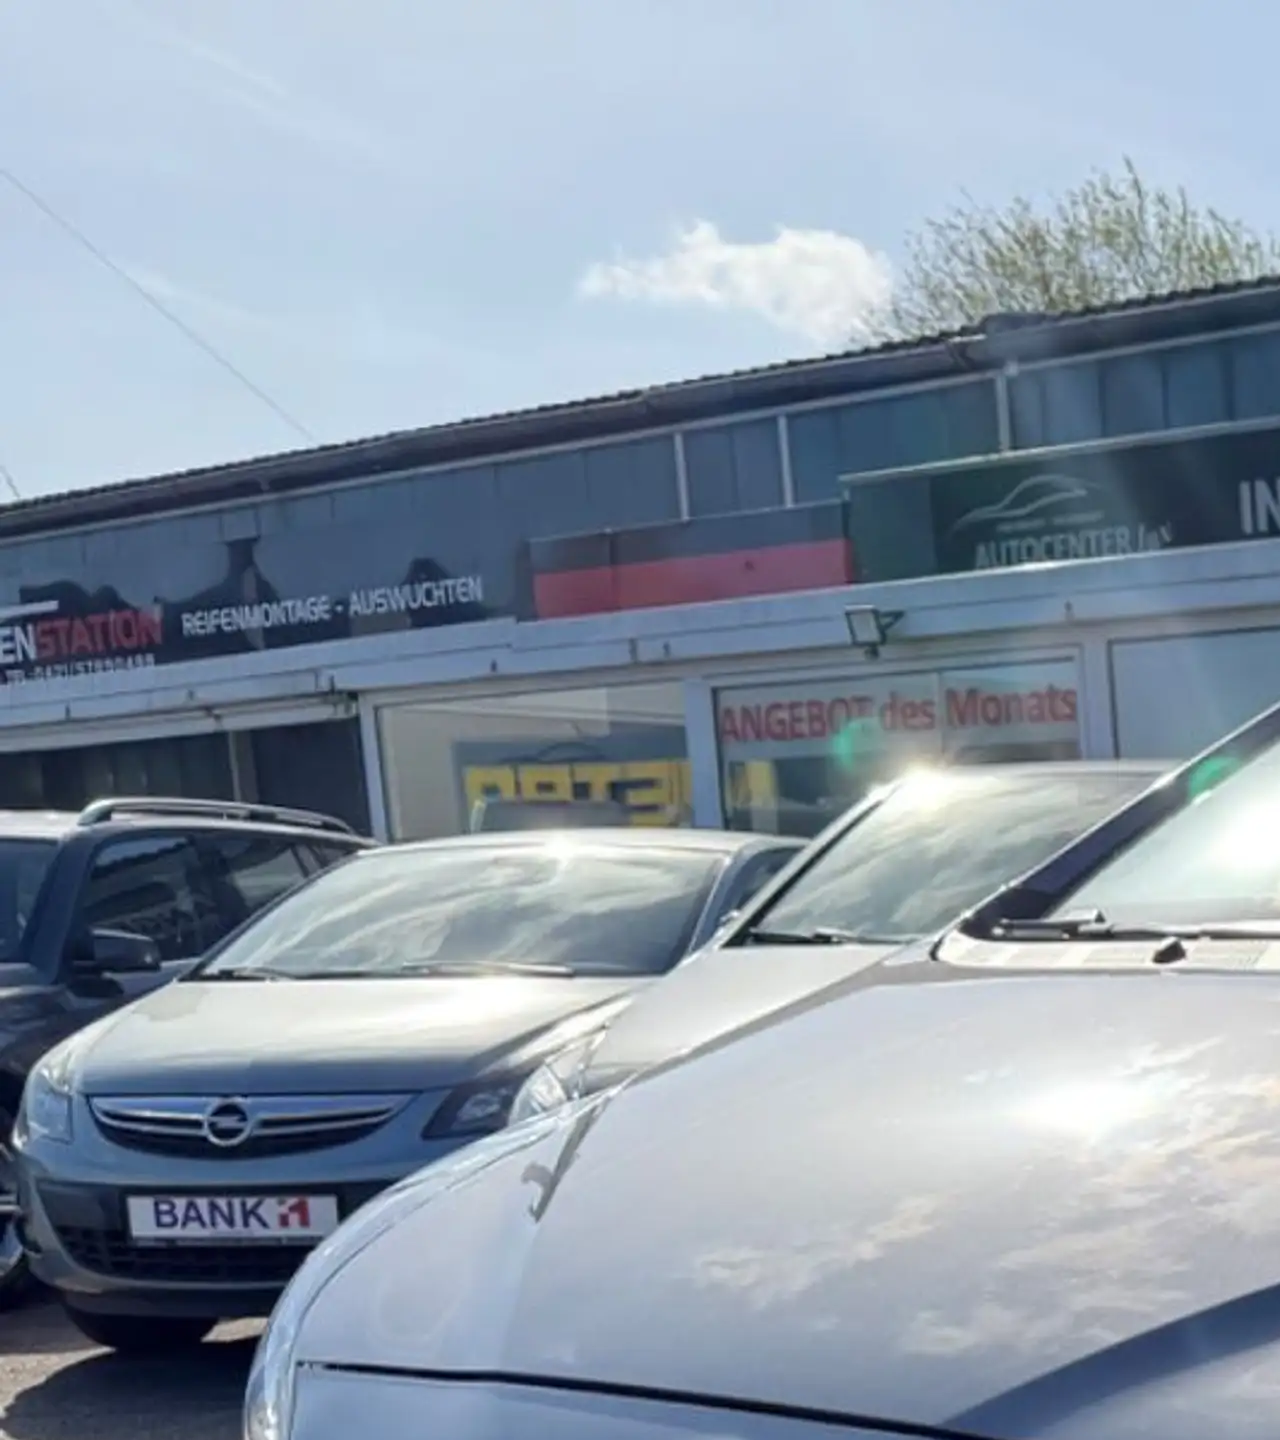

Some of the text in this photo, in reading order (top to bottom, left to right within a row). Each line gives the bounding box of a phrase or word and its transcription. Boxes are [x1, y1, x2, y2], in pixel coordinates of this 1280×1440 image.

[974, 523, 1133, 568] AUTOCENTER
[181, 594, 333, 636] REIFENMONTAGE
[350, 575, 484, 616] AUSWUCHTEN
[879, 690, 936, 731] des
[944, 685, 1077, 729] Monats
